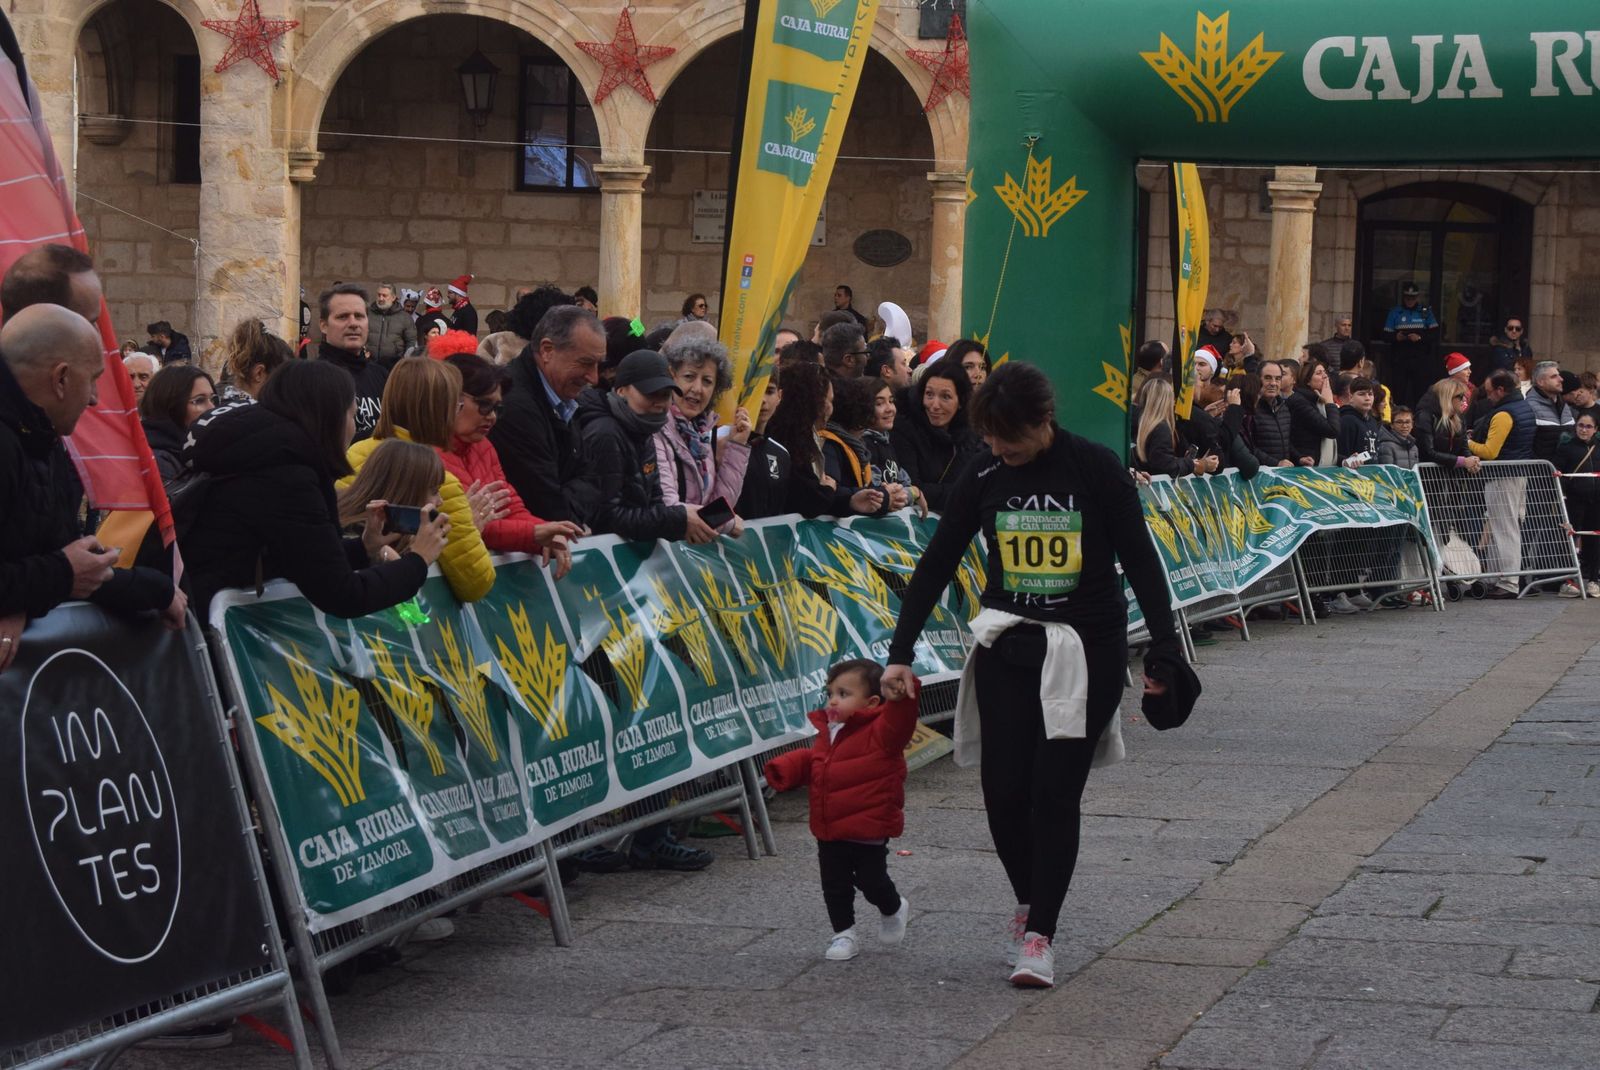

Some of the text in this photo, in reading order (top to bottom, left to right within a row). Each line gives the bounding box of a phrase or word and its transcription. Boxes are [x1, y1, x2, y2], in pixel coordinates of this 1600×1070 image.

[780, 15, 849, 40] CAJA RURAL
[1302, 34, 1503, 104] CAJA
[1006, 535, 1069, 568] 109
[1022, 578, 1043, 588] CAJA
[615, 712, 683, 754] CAJA RURAL
[525, 740, 604, 787] CAJA RURAL
[632, 741, 676, 770] DE ZAMORA
[544, 785, 559, 803] DE
[558, 772, 594, 797] ZAMORA
[299, 825, 359, 868] CAJA
[355, 803, 416, 846] RURAL
[78, 842, 161, 905] TES
[333, 839, 412, 885] DE ZAMORA
